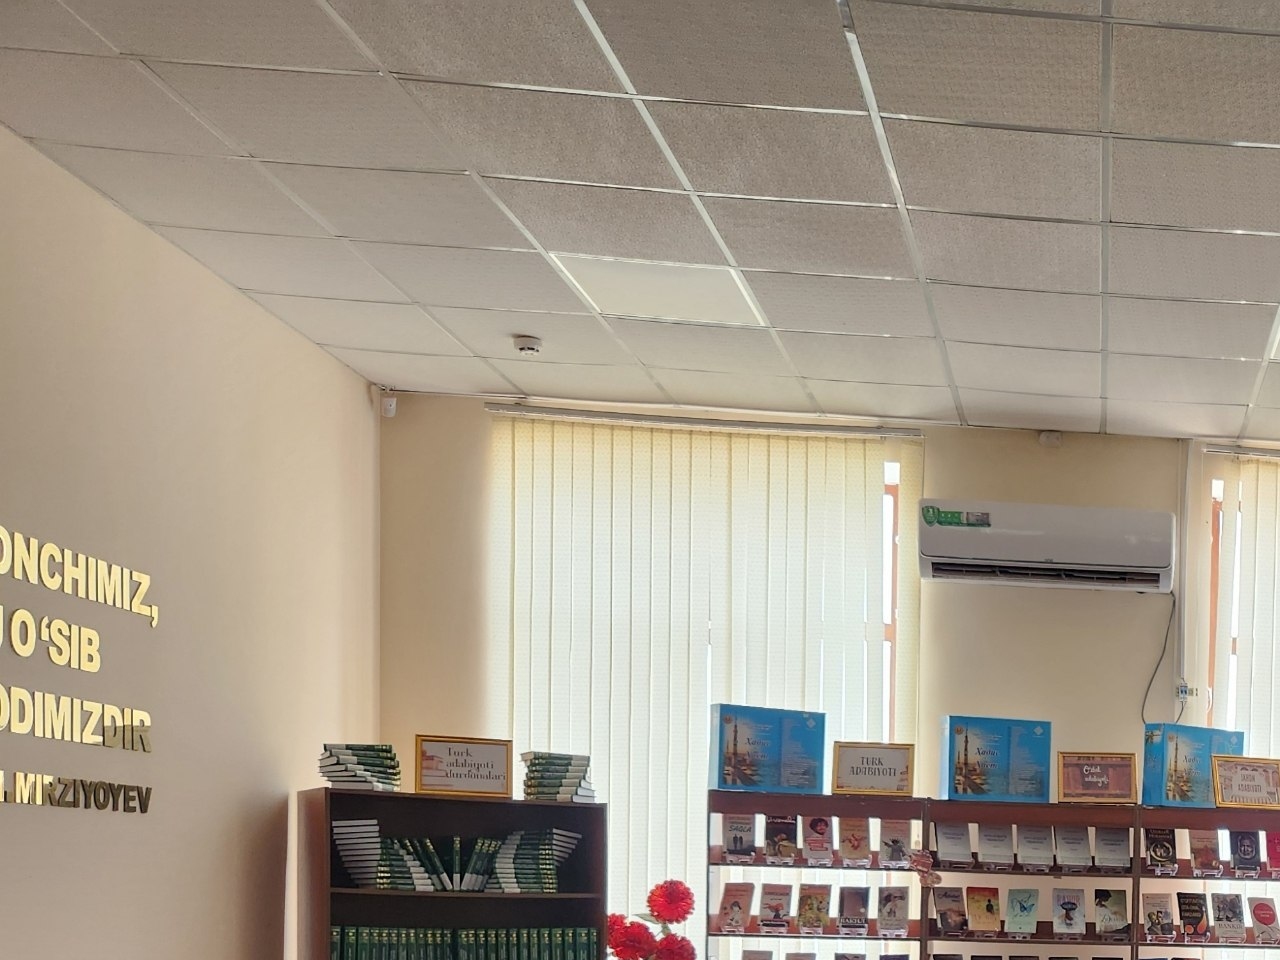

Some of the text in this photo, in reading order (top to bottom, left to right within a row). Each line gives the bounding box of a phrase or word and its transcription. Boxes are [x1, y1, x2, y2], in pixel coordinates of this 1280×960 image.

[860, 756, 884, 767] TURK
[849, 766, 897, 777] ADABIYOTI
[15, 771, 153, 814] MIRZIYOYEV
